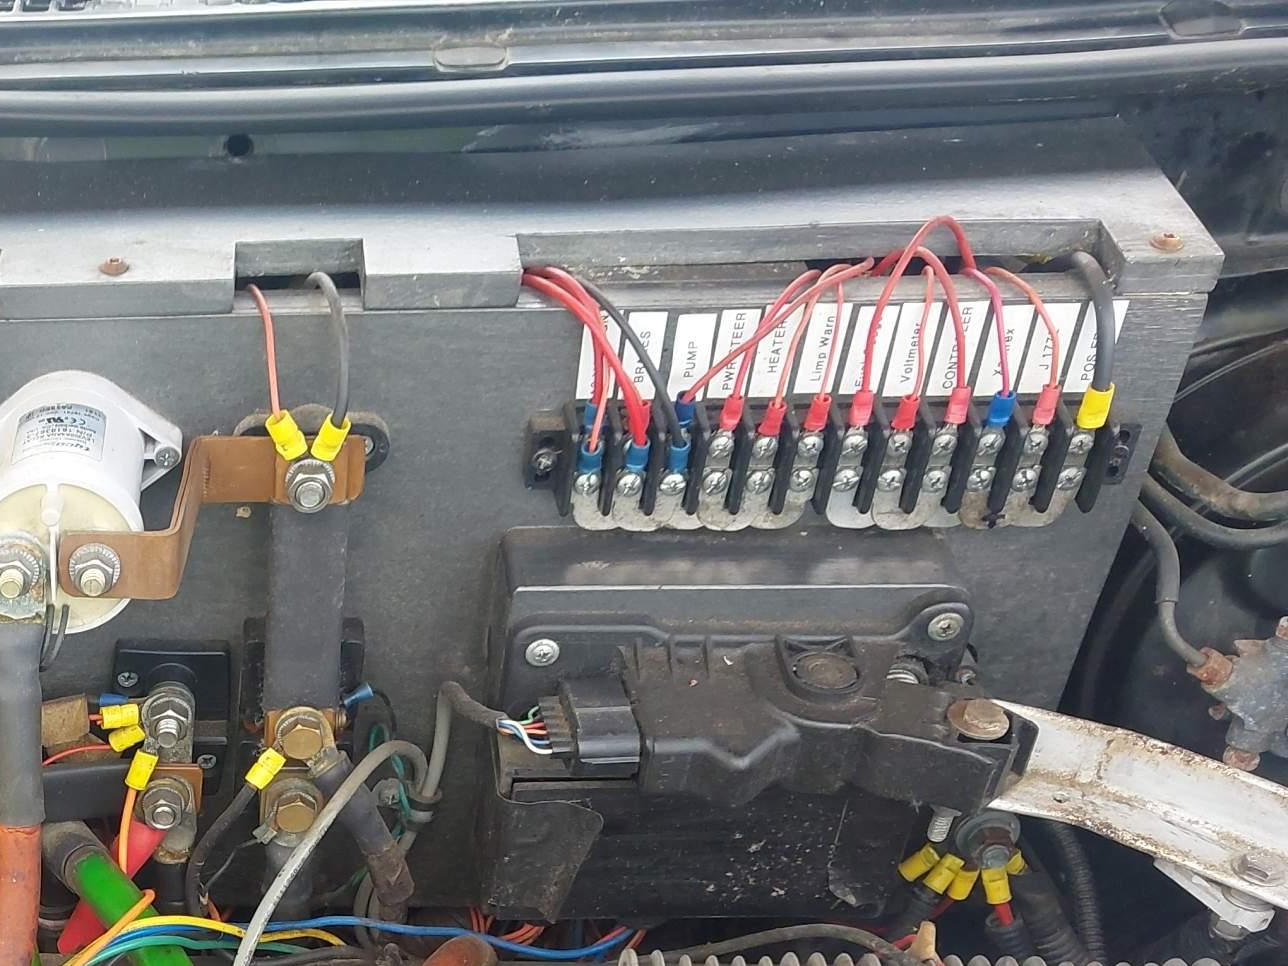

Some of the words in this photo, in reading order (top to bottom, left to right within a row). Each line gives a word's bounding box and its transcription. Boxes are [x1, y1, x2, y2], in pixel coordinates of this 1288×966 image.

[767, 318, 787, 374] HEATER
[818, 315, 835, 349] Warn
[899, 322, 921, 384] Voltmeter
[942, 306, 974, 390] CONTRLER
[634, 330, 651, 384] BRAES
[683, 341, 698, 378] PUMP
[722, 363, 737, 391] PWR
[810, 352, 827, 382] Limp
